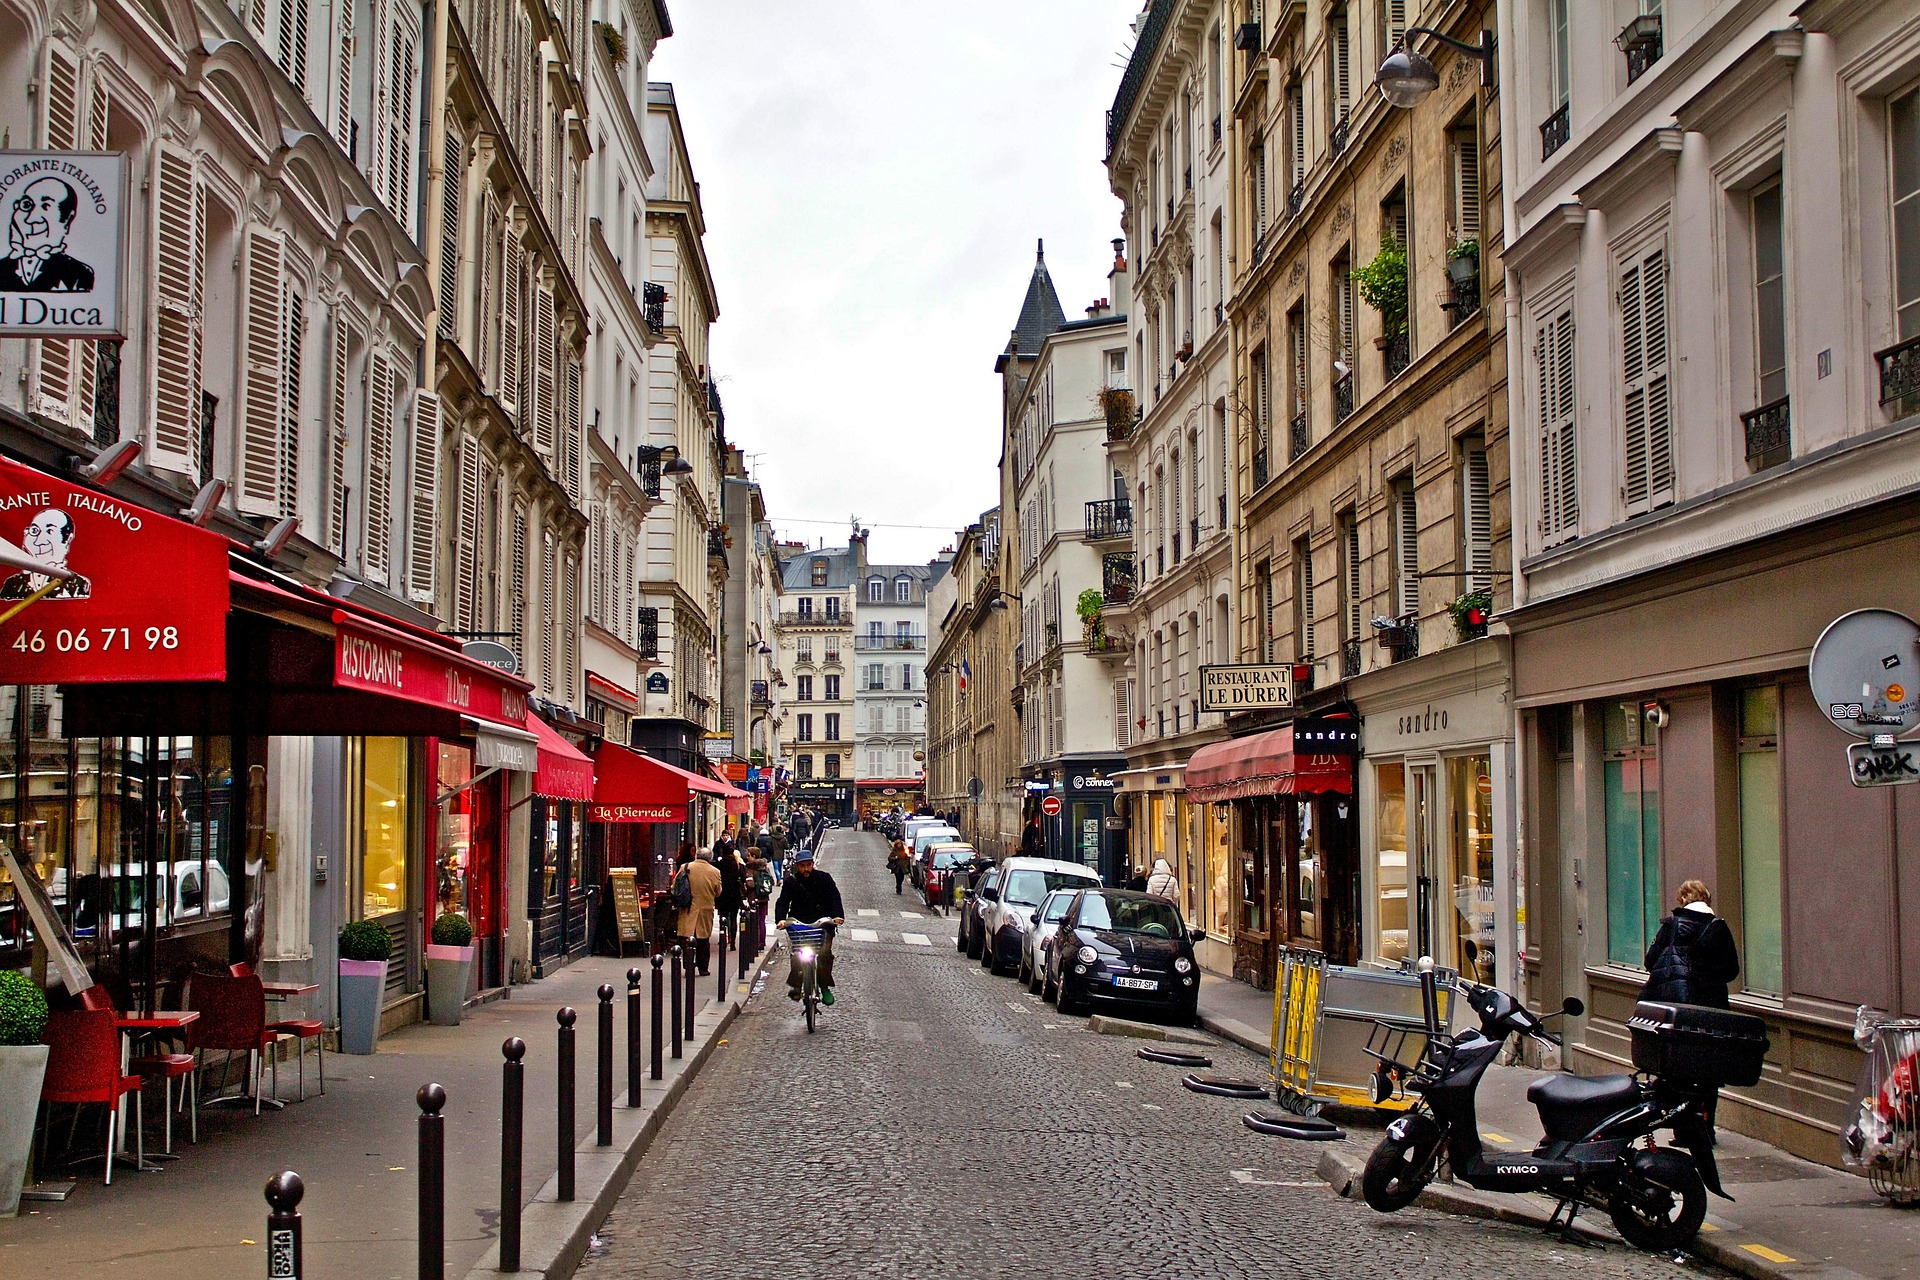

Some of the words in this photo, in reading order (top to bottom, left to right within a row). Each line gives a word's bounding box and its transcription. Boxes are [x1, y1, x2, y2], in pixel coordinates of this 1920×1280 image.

[62, 162, 107, 215] ITALIANO
[18, 297, 103, 326] Duca
[66, 492, 142, 532] ITALIANO
[12, 629, 46, 653] 46
[56, 628, 91, 652] 06
[101, 627, 131, 651] 71
[144, 626, 179, 650] 98
[341, 633, 403, 689] RISTORANTE
[1207, 669, 1288, 686] RESTAURANT
[1208, 688, 1228, 705] LE
[1232, 684, 1289, 704] DÜRER
[1398, 703, 1449, 736] sandro
[1294, 730, 1358, 741] sandro
[594, 806, 614, 821] La
[614, 806, 672, 821] Pierrade
[1496, 1165, 1539, 1174] KYMCO
